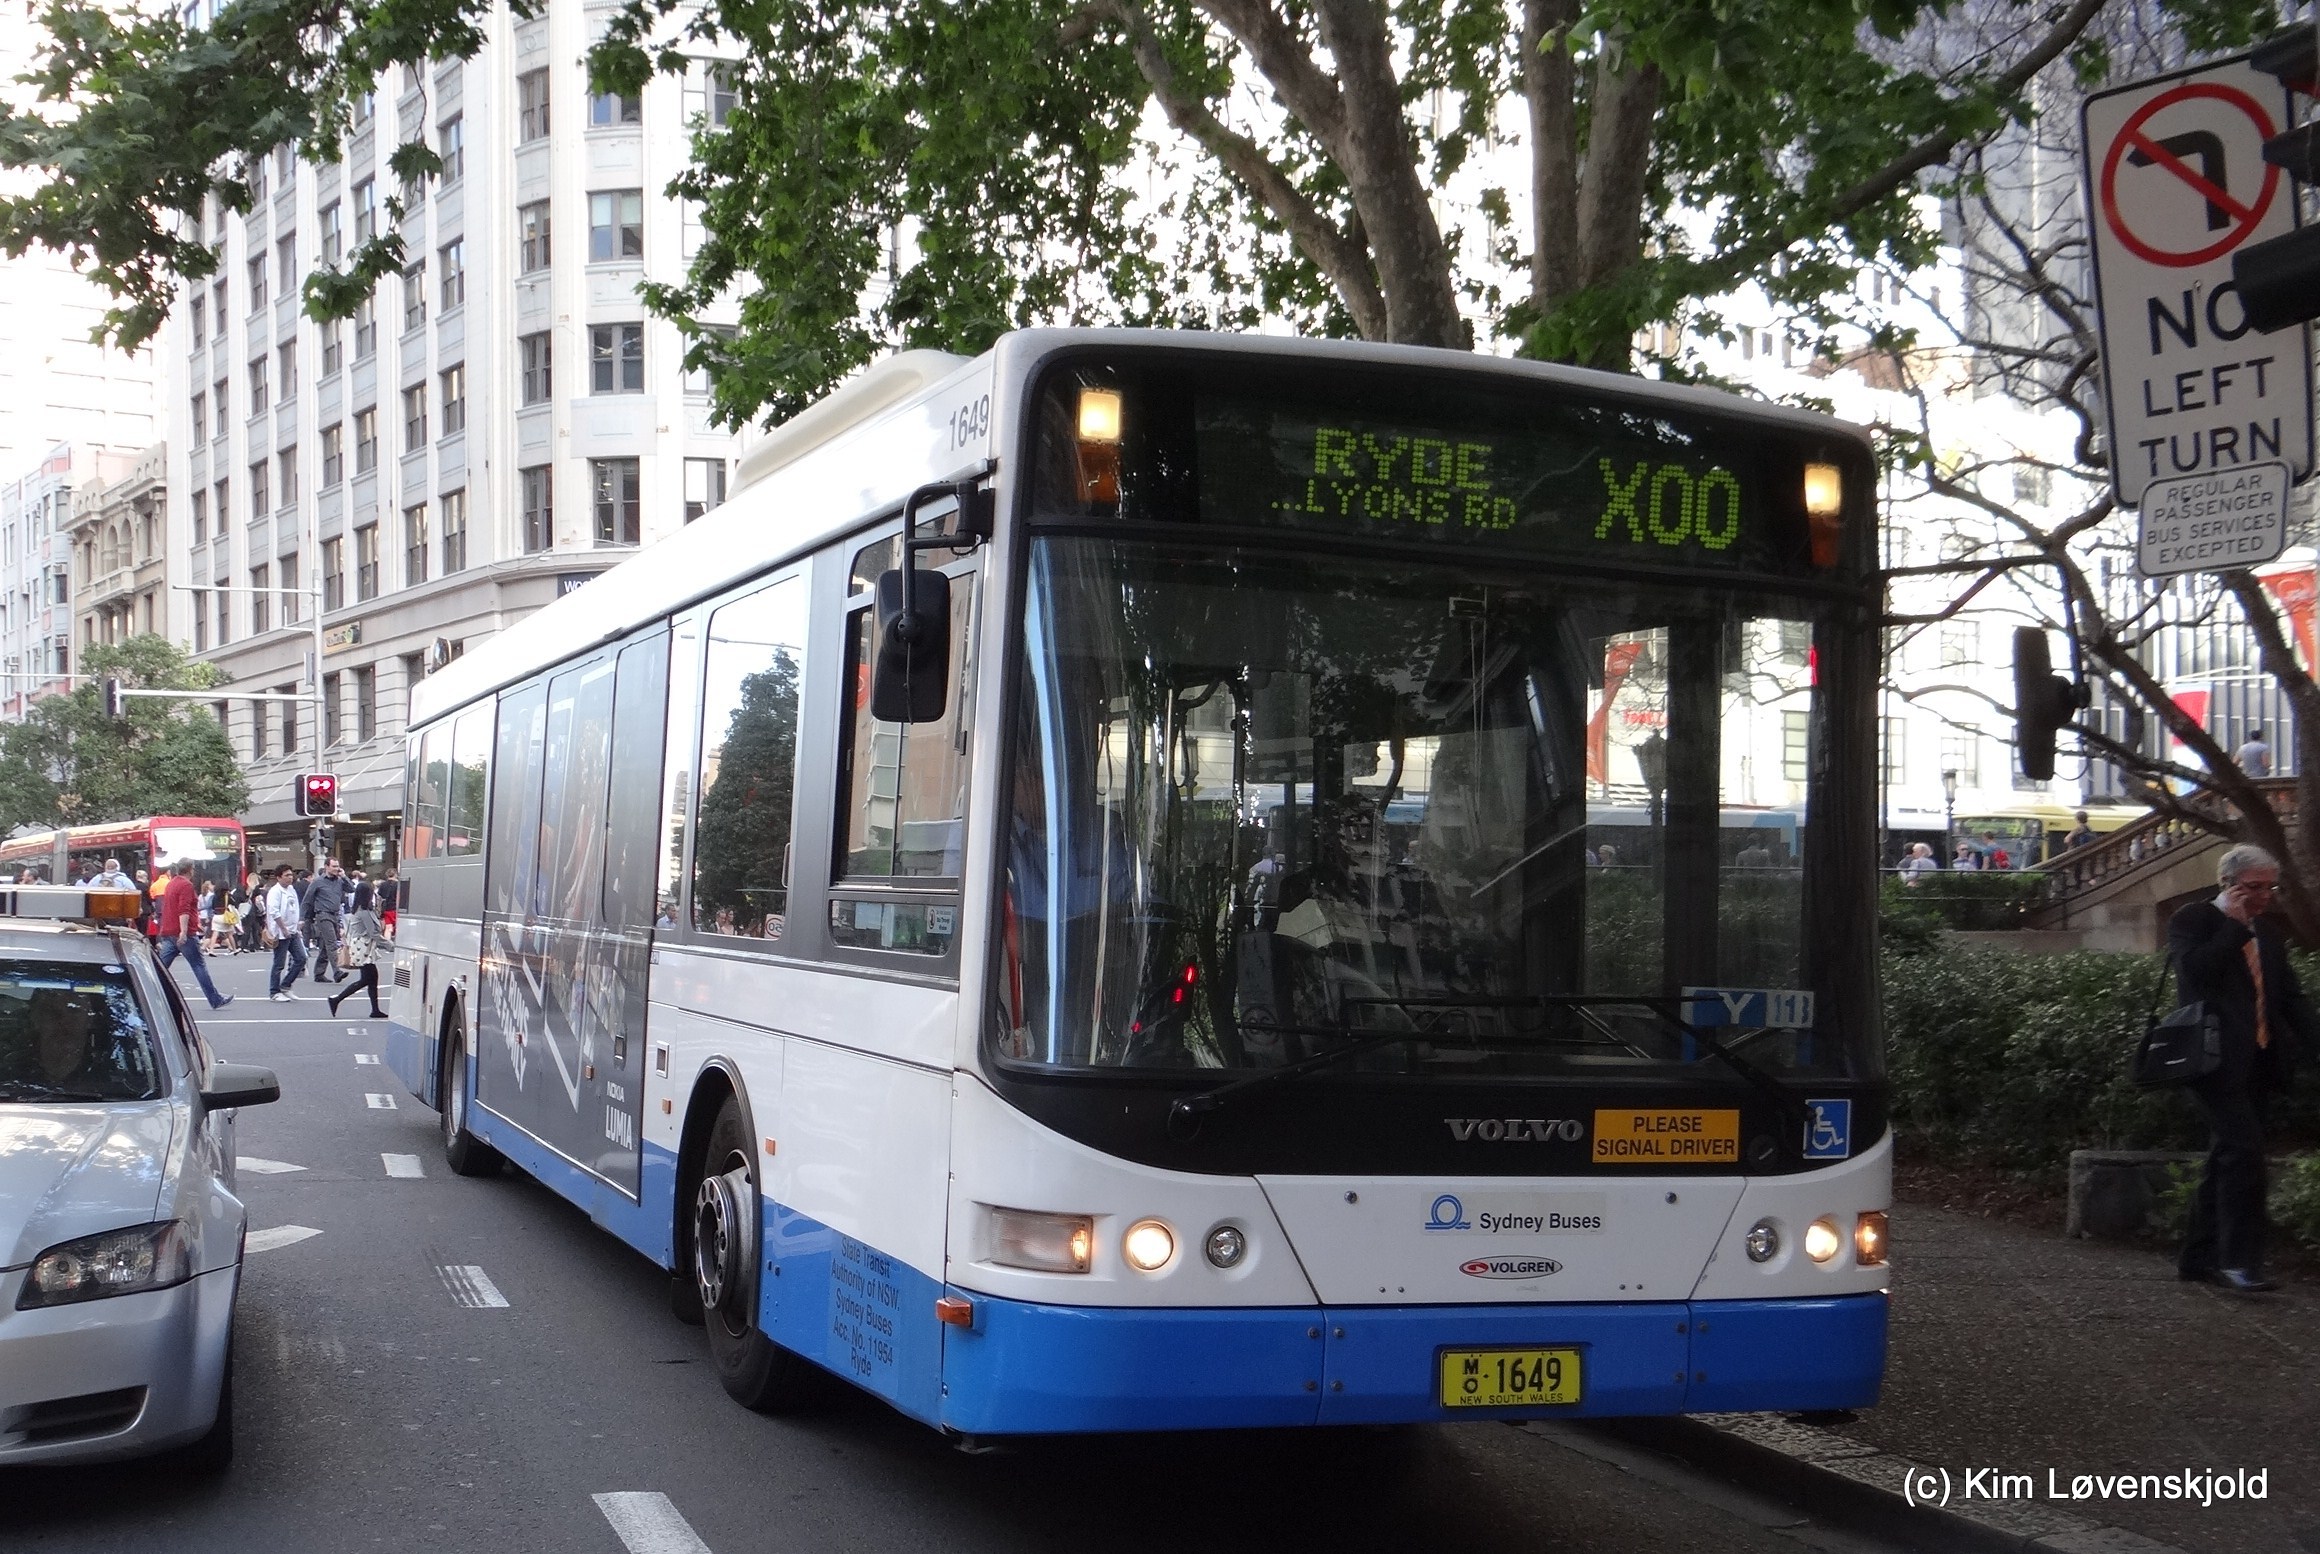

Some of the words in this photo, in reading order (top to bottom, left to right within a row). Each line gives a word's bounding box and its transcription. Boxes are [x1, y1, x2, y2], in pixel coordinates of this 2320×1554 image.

[2147, 280, 2250, 355] NO
[2143, 356, 2275, 418] LEFT
[949, 394, 990, 452] 1649
[1314, 428, 1492, 490] RYDE
[2138, 417, 2281, 477] TURN
[2166, 474, 2262, 504] REGULAR
[1464, 495, 1516, 530] RD
[2153, 491, 2273, 523] PASSENGER
[2147, 527, 2181, 545] BUS
[2189, 512, 2276, 539] SERVICES
[2159, 536, 2264, 564] EXCEPTED
[1718, 992, 1755, 1024] Y
[607, 1080, 625, 1103] NOKIA
[605, 1104, 633, 1151] LUMIA
[1444, 1118, 1584, 1142] VOLVO
[1633, 1116, 1702, 1132] PLEASE
[1597, 1138, 1665, 1155] SIGNAL
[1670, 1138, 1736, 1156] DRIVER
[1479, 1212, 1544, 1232] Sydney
[1549, 1213, 1601, 1229] Buses
[841, 1237, 861, 1265] State
[863, 1245, 891, 1279] Transit
[1490, 1260, 1555, 1274] VOLGREN
[831, 1258, 865, 1298] Authority
[866, 1278, 876, 1298] of
[836, 1287, 865, 1326] Sydney
[866, 1304, 893, 1338] Buses
[832, 1315, 850, 1343] Acc.
[852, 1325, 866, 1352] No.
[868, 1335, 894, 1367] 11954
[850, 1346, 872, 1378] Ryde
[1497, 1358, 1562, 1393] 1649
[1460, 1396, 1483, 1405] NEW
[1488, 1394, 1524, 1404] SOUTH
[1529, 1393, 1564, 1403] WALES
